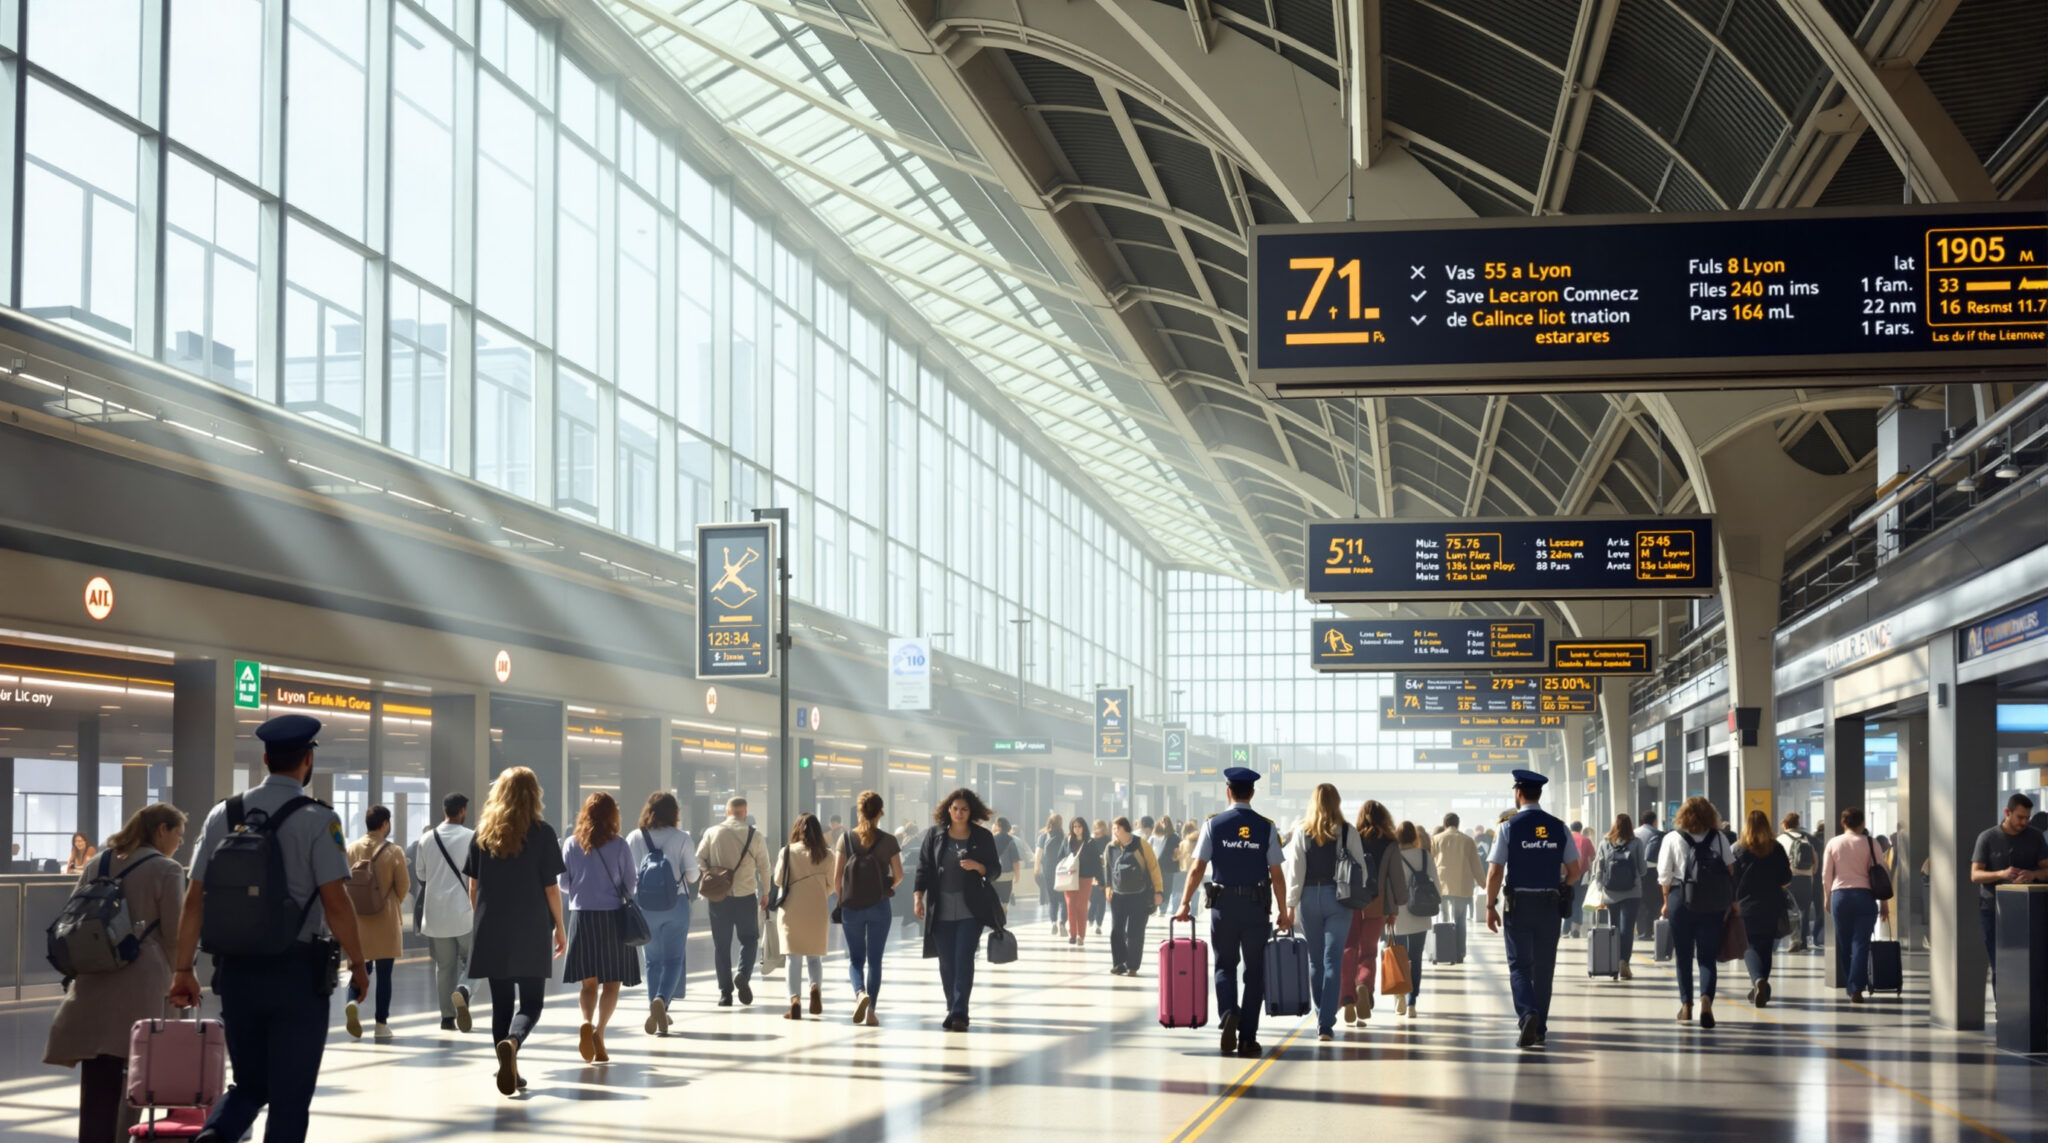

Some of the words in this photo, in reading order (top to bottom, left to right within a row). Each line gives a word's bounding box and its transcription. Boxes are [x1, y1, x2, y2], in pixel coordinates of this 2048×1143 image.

[1936, 236, 2006, 265] 1905
[2019, 249, 2035, 263] M
[1445, 264, 1476, 280] Vas
[1483, 262, 1507, 280] 55
[1511, 265, 1523, 279] a
[1527, 262, 1572, 281] Lyon
[1688, 258, 1724, 275] Fuls
[1727, 258, 1739, 274] 8
[1743, 257, 1786, 275] Lyon
[1688, 281, 1727, 298] Files
[1731, 281, 1764, 297] 240
[1768, 282, 1785, 297] m
[1789, 280, 1820, 296] ims
[1860, 277, 1870, 293] 1
[1875, 277, 1914, 293] fam.
[1938, 277, 1960, 294] 33
[1445, 288, 1485, 305] Save
[1689, 305, 1728, 321] Pars
[1731, 304, 1764, 320] 164
[1768, 304, 1795, 320] mL
[1863, 298, 1885, 315] 22
[1889, 299, 1917, 314] nm
[1939, 298, 1962, 316] 16
[1446, 312, 1468, 328] de
[1570, 308, 1631, 325] tnation
[1860, 320, 1870, 335] 1
[1875, 320, 1915, 335] Fars.
[1978, 330, 1997, 341] the
